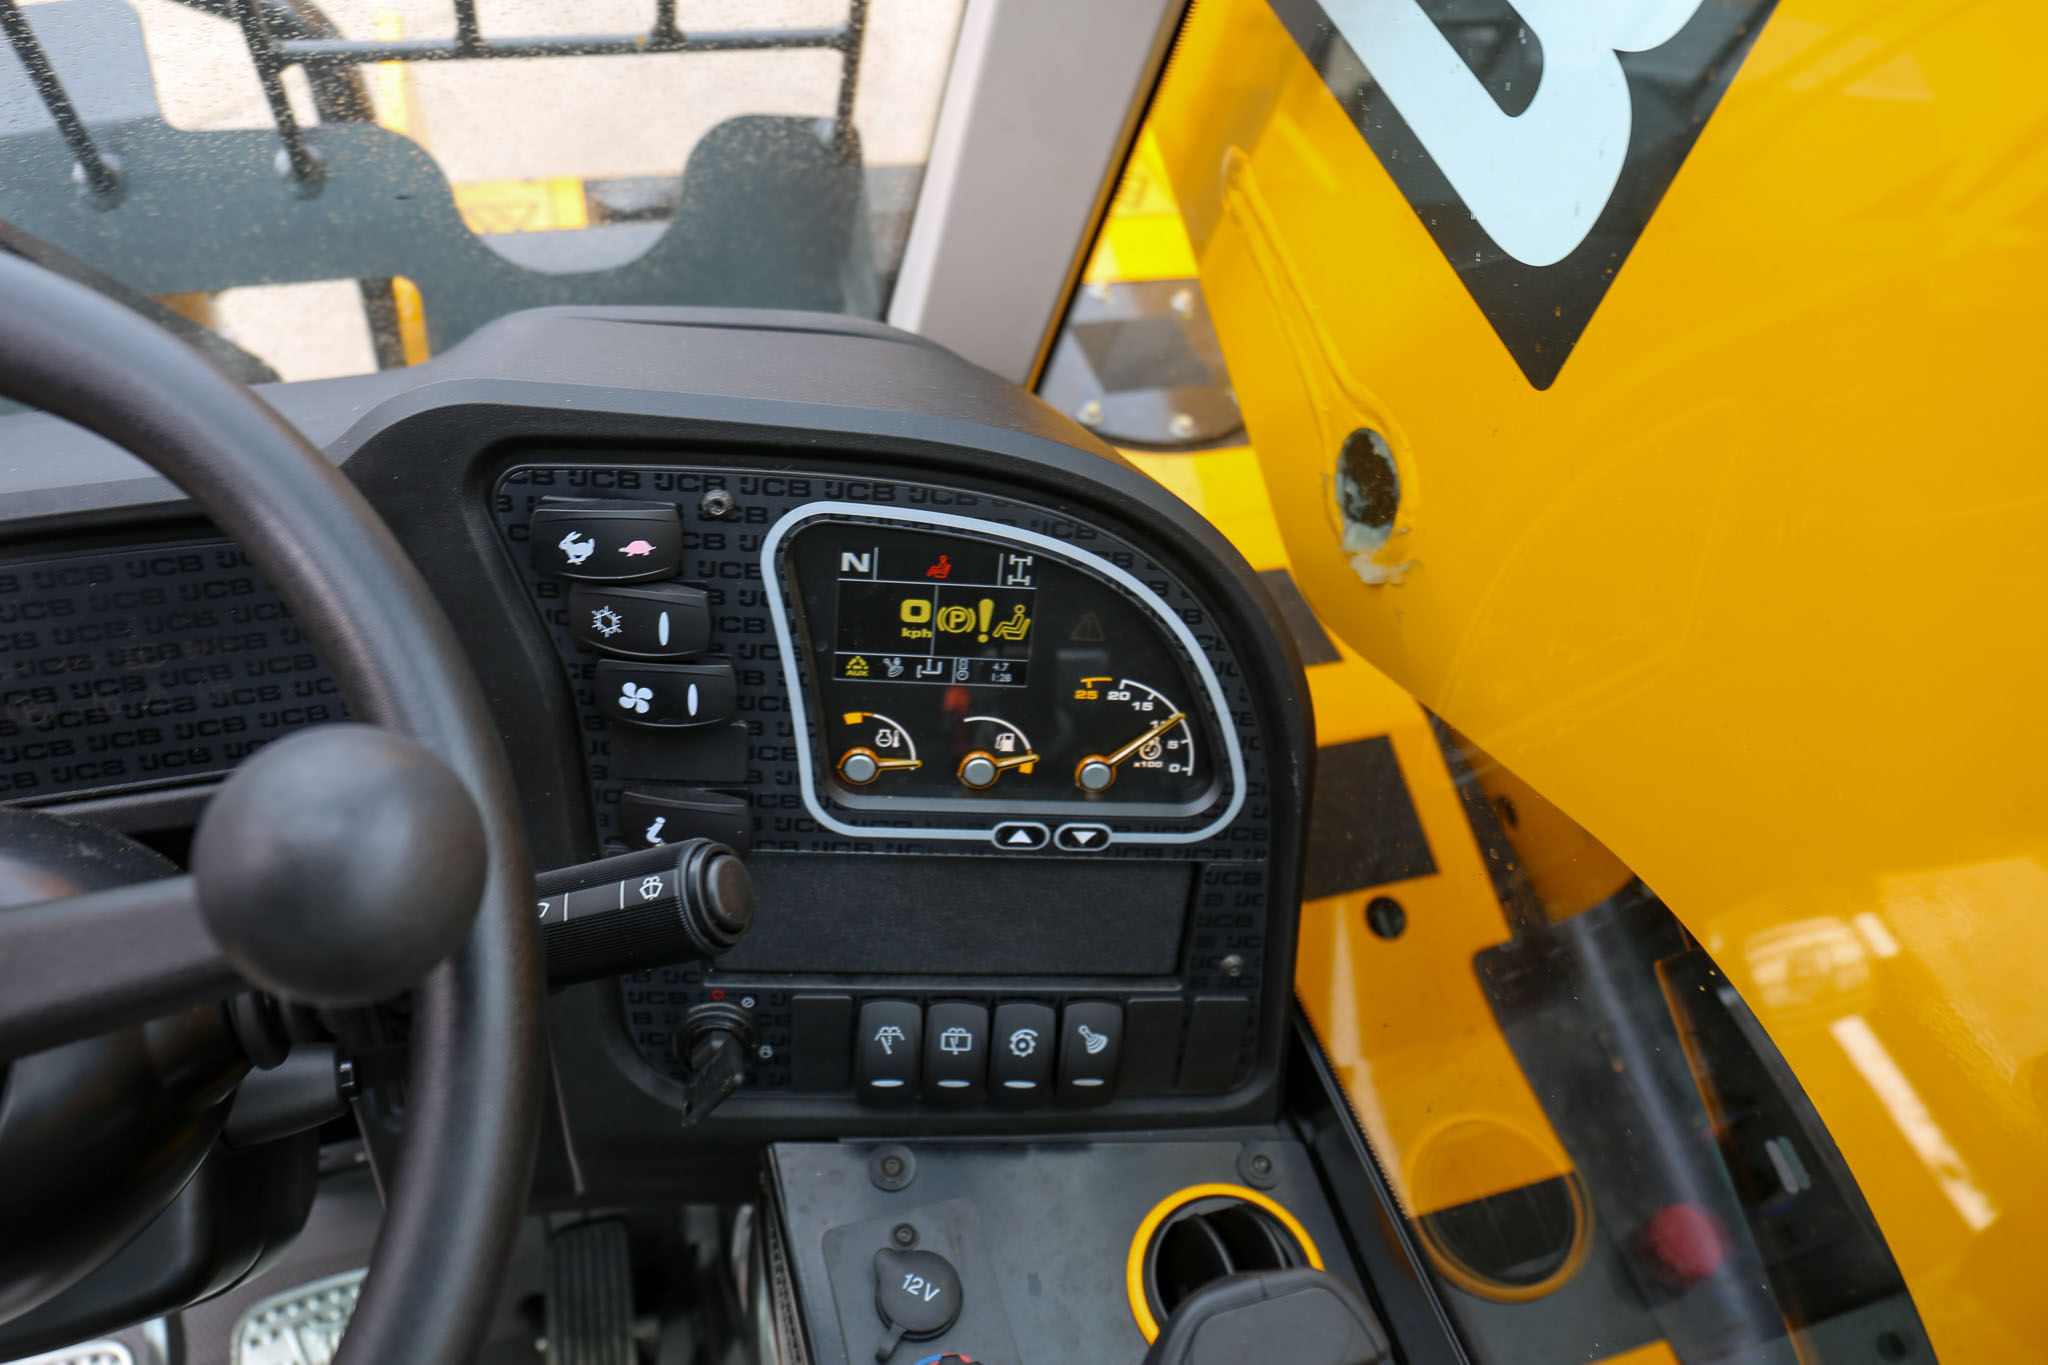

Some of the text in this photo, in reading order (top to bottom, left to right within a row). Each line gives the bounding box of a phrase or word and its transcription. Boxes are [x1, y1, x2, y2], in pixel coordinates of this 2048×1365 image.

[568, 470, 641, 489] JCB
[740, 477, 811, 497] JCB
[825, 482, 895, 501] JCB
[126, 555, 205, 579] JCB
[841, 552, 871, 572] N
[179, 578, 255, 601] JCB
[900, 599, 932, 623] 0
[901, 628, 933, 639] kph
[69, 676, 146, 700] JCB
[246, 654, 318, 677] JCB
[1074, 690, 1099, 700] 25
[1107, 691, 1131, 701] 20
[1131, 702, 1154, 711] 15
[87, 728, 163, 752] JCB
[174, 716, 247, 740] JCB
[259, 704, 330, 728] JCB
[1167, 740, 1179, 750] 5
[51, 760, 126, 783] JCB
[138, 747, 213, 771] JCB
[1168, 763, 1180, 773] 0
[902, 1273, 941, 1302] 12V
